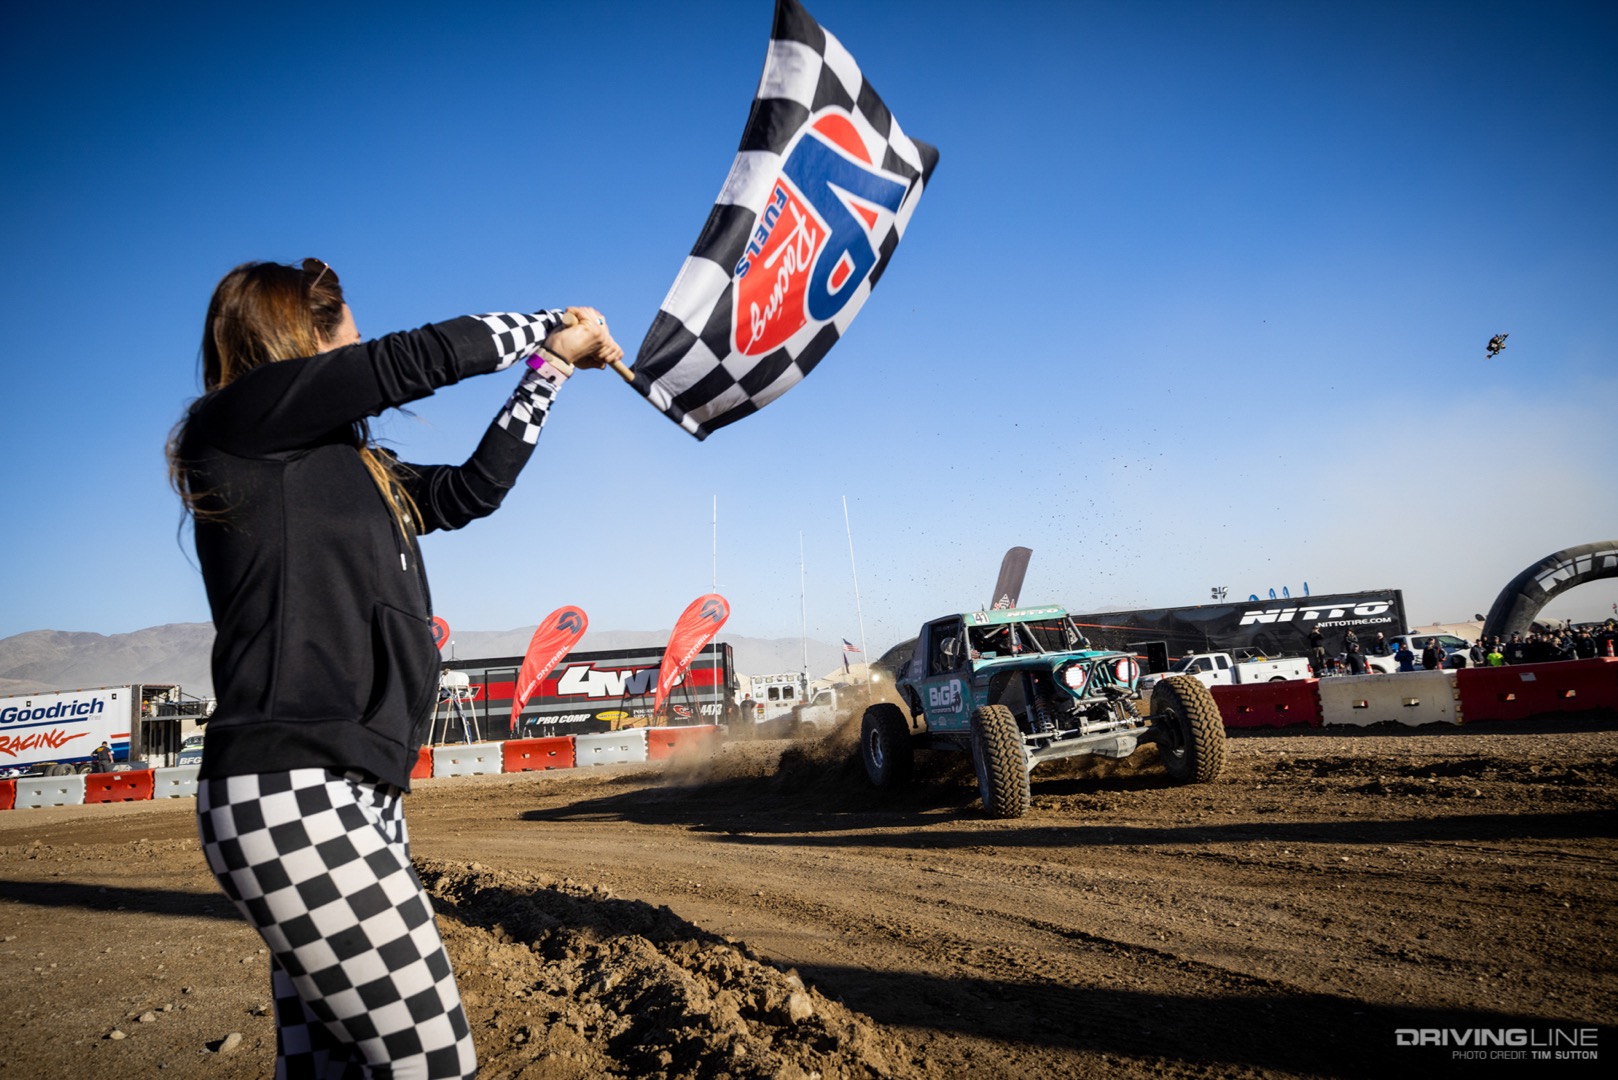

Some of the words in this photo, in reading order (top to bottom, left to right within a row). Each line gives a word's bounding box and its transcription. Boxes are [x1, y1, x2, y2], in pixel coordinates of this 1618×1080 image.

[735, 186, 789, 279] FUELS
[782, 132, 907, 321] VP
[743, 201, 816, 356] Racing
[1007, 608, 1059, 617] NITTO
[1239, 601, 1389, 625] NITTO
[1317, 617, 1391, 628] NITTOTIRE.COM
[536, 645, 569, 680] ONTRAIL
[680, 634, 710, 666] ONTRAIL
[536, 716, 559, 725] PRO
[559, 713, 591, 723] COMP
[701, 704, 722, 716] 4473
[0, 728, 90, 757] RACING
